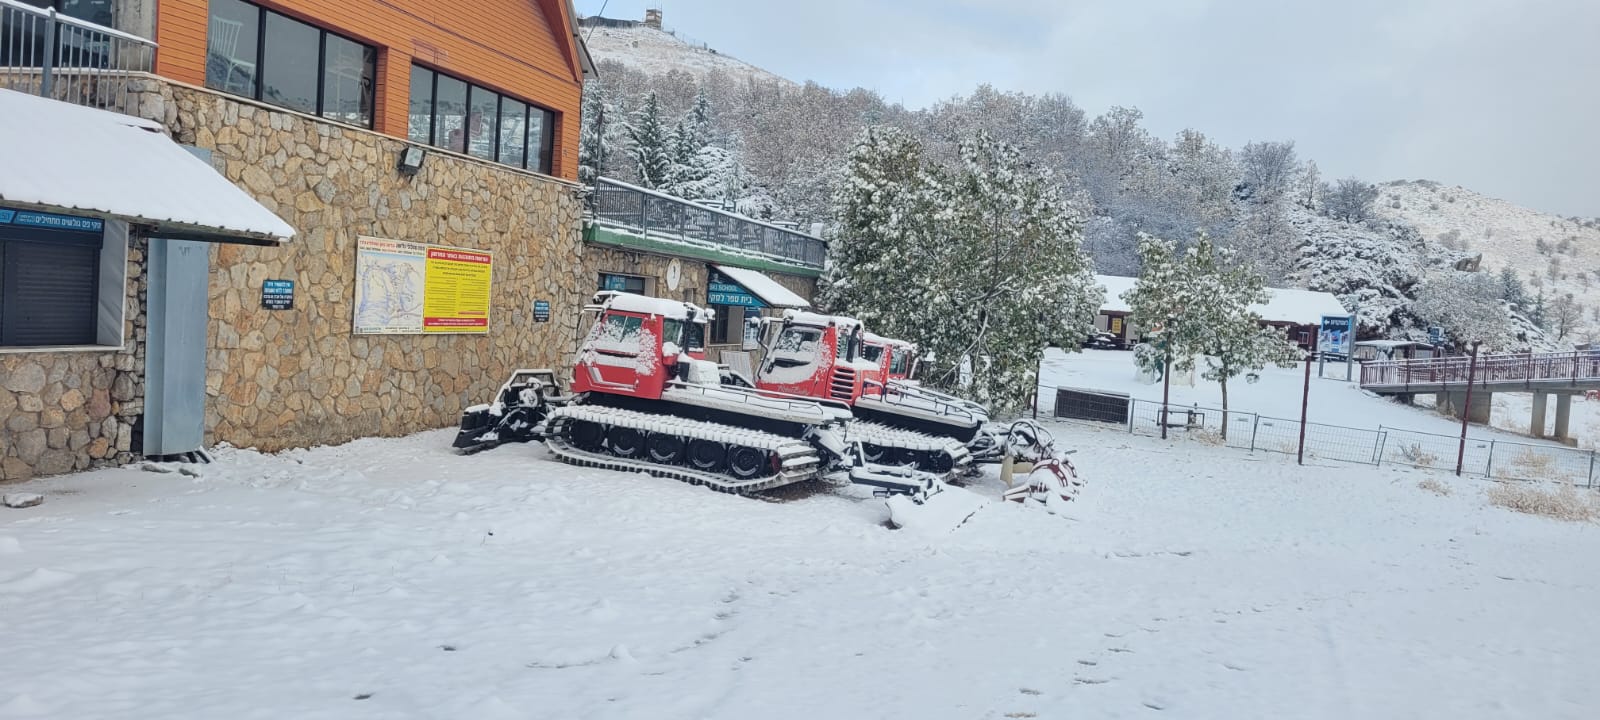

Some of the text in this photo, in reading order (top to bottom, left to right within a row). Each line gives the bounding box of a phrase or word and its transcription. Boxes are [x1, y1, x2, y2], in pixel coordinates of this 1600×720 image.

[35, 214, 60, 225] מתחילים
[708, 293, 753, 304] בית ספר לסקי
